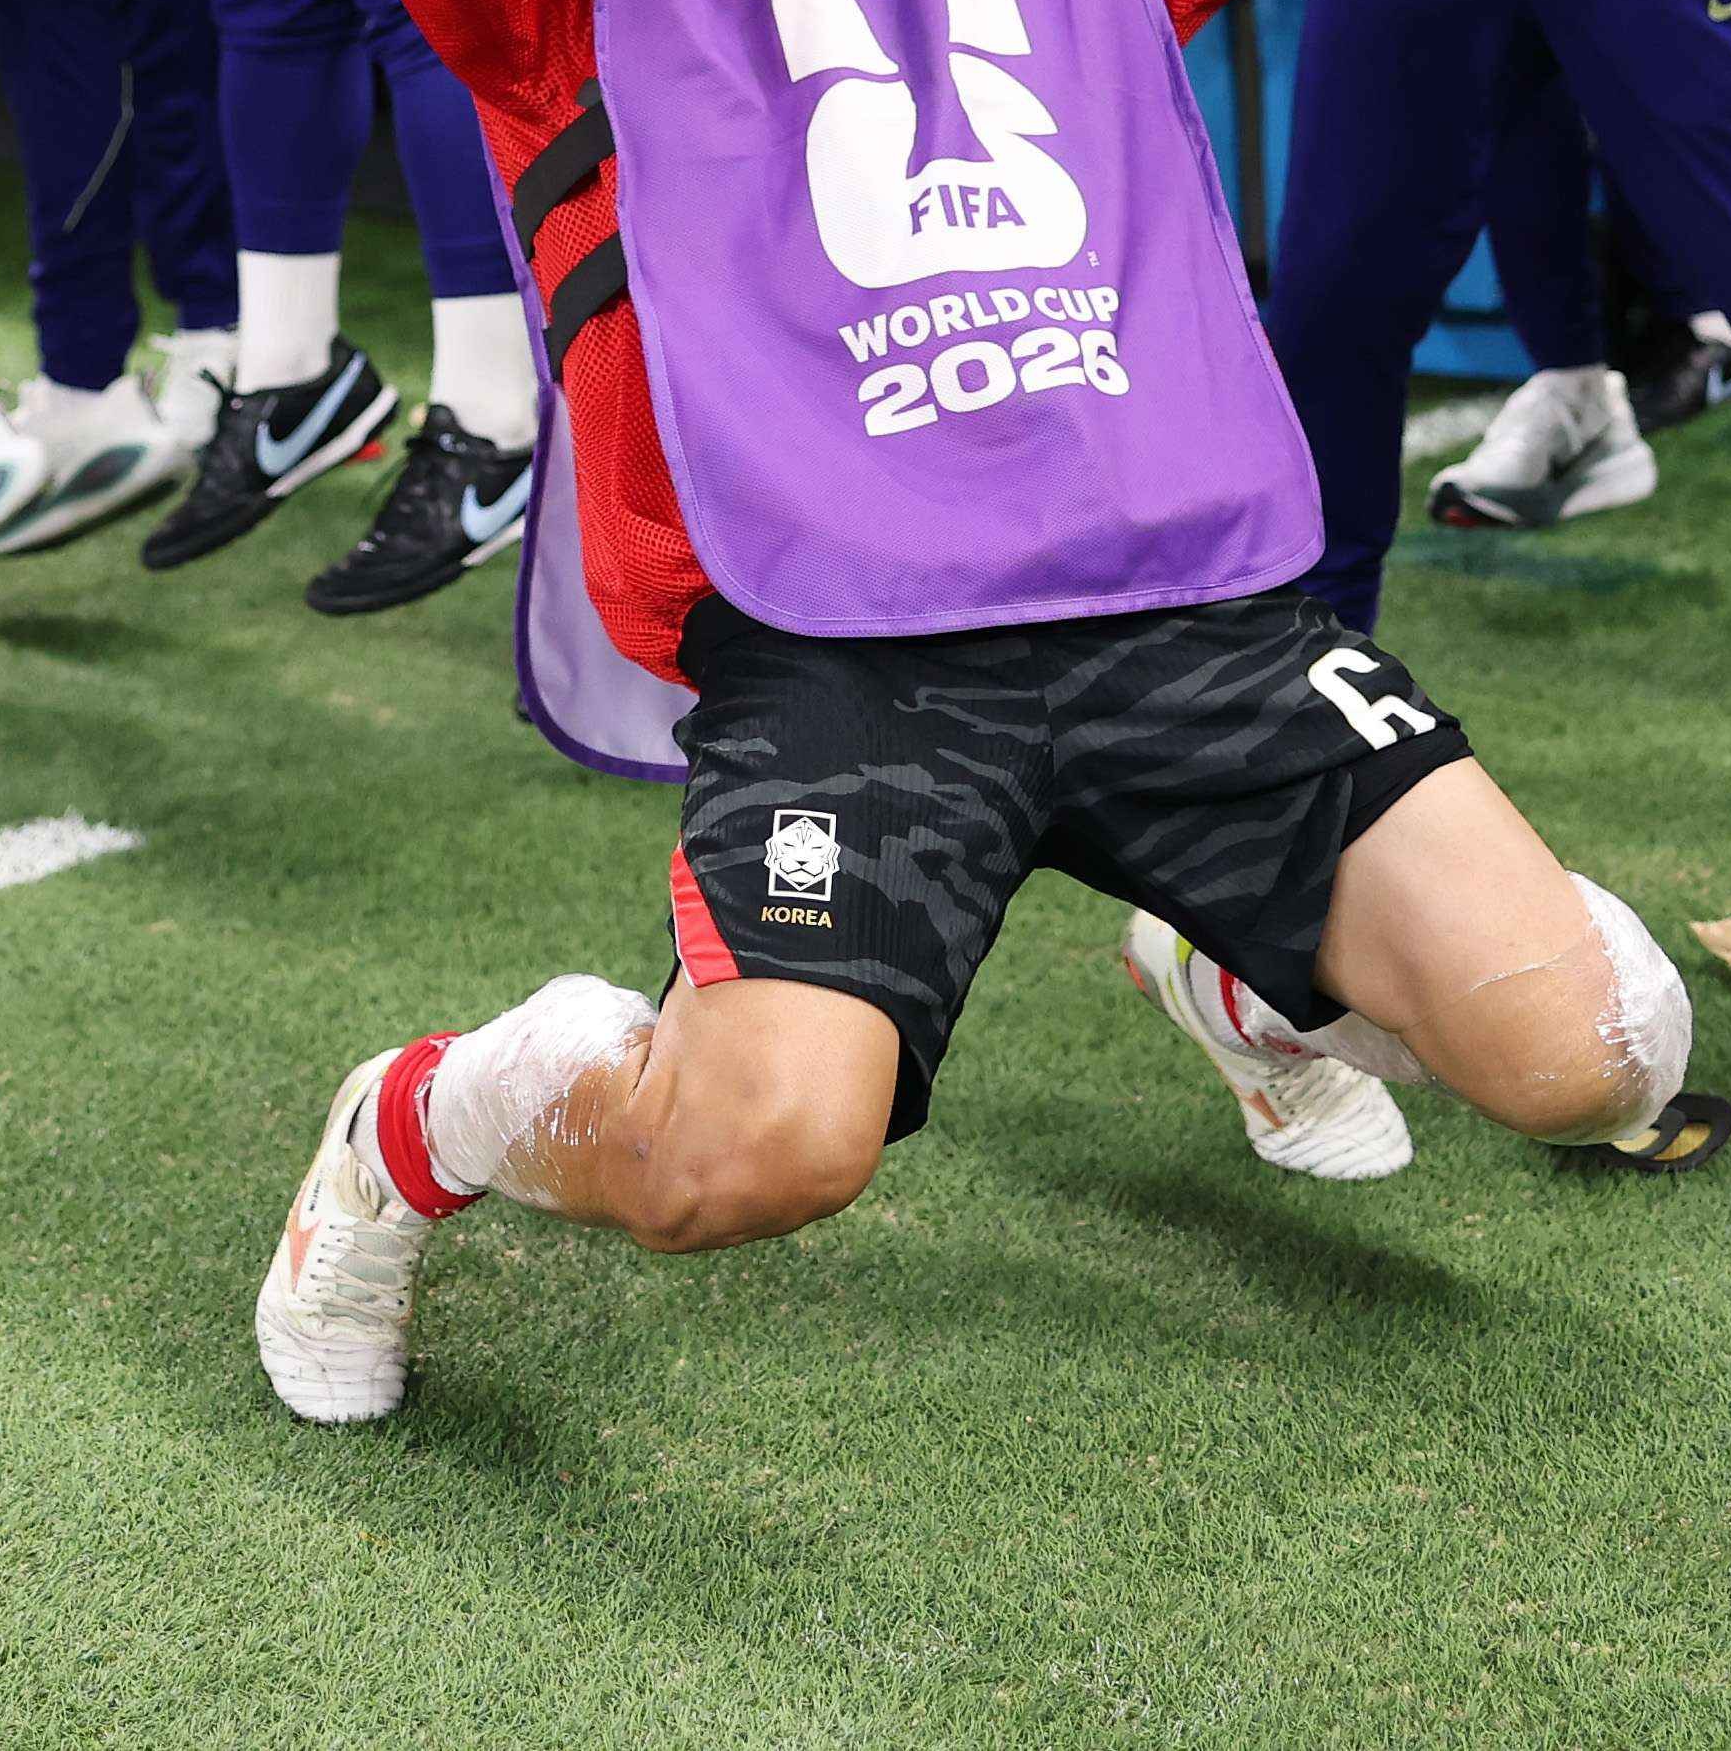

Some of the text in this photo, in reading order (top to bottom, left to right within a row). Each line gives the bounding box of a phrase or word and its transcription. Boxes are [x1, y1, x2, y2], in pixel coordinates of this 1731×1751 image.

[909, 184, 1027, 237] FIFA
[838, 285, 1120, 364] WORLD CUP
[857, 326, 1131, 438] 2026
[760, 905, 833, 929] KOREA
